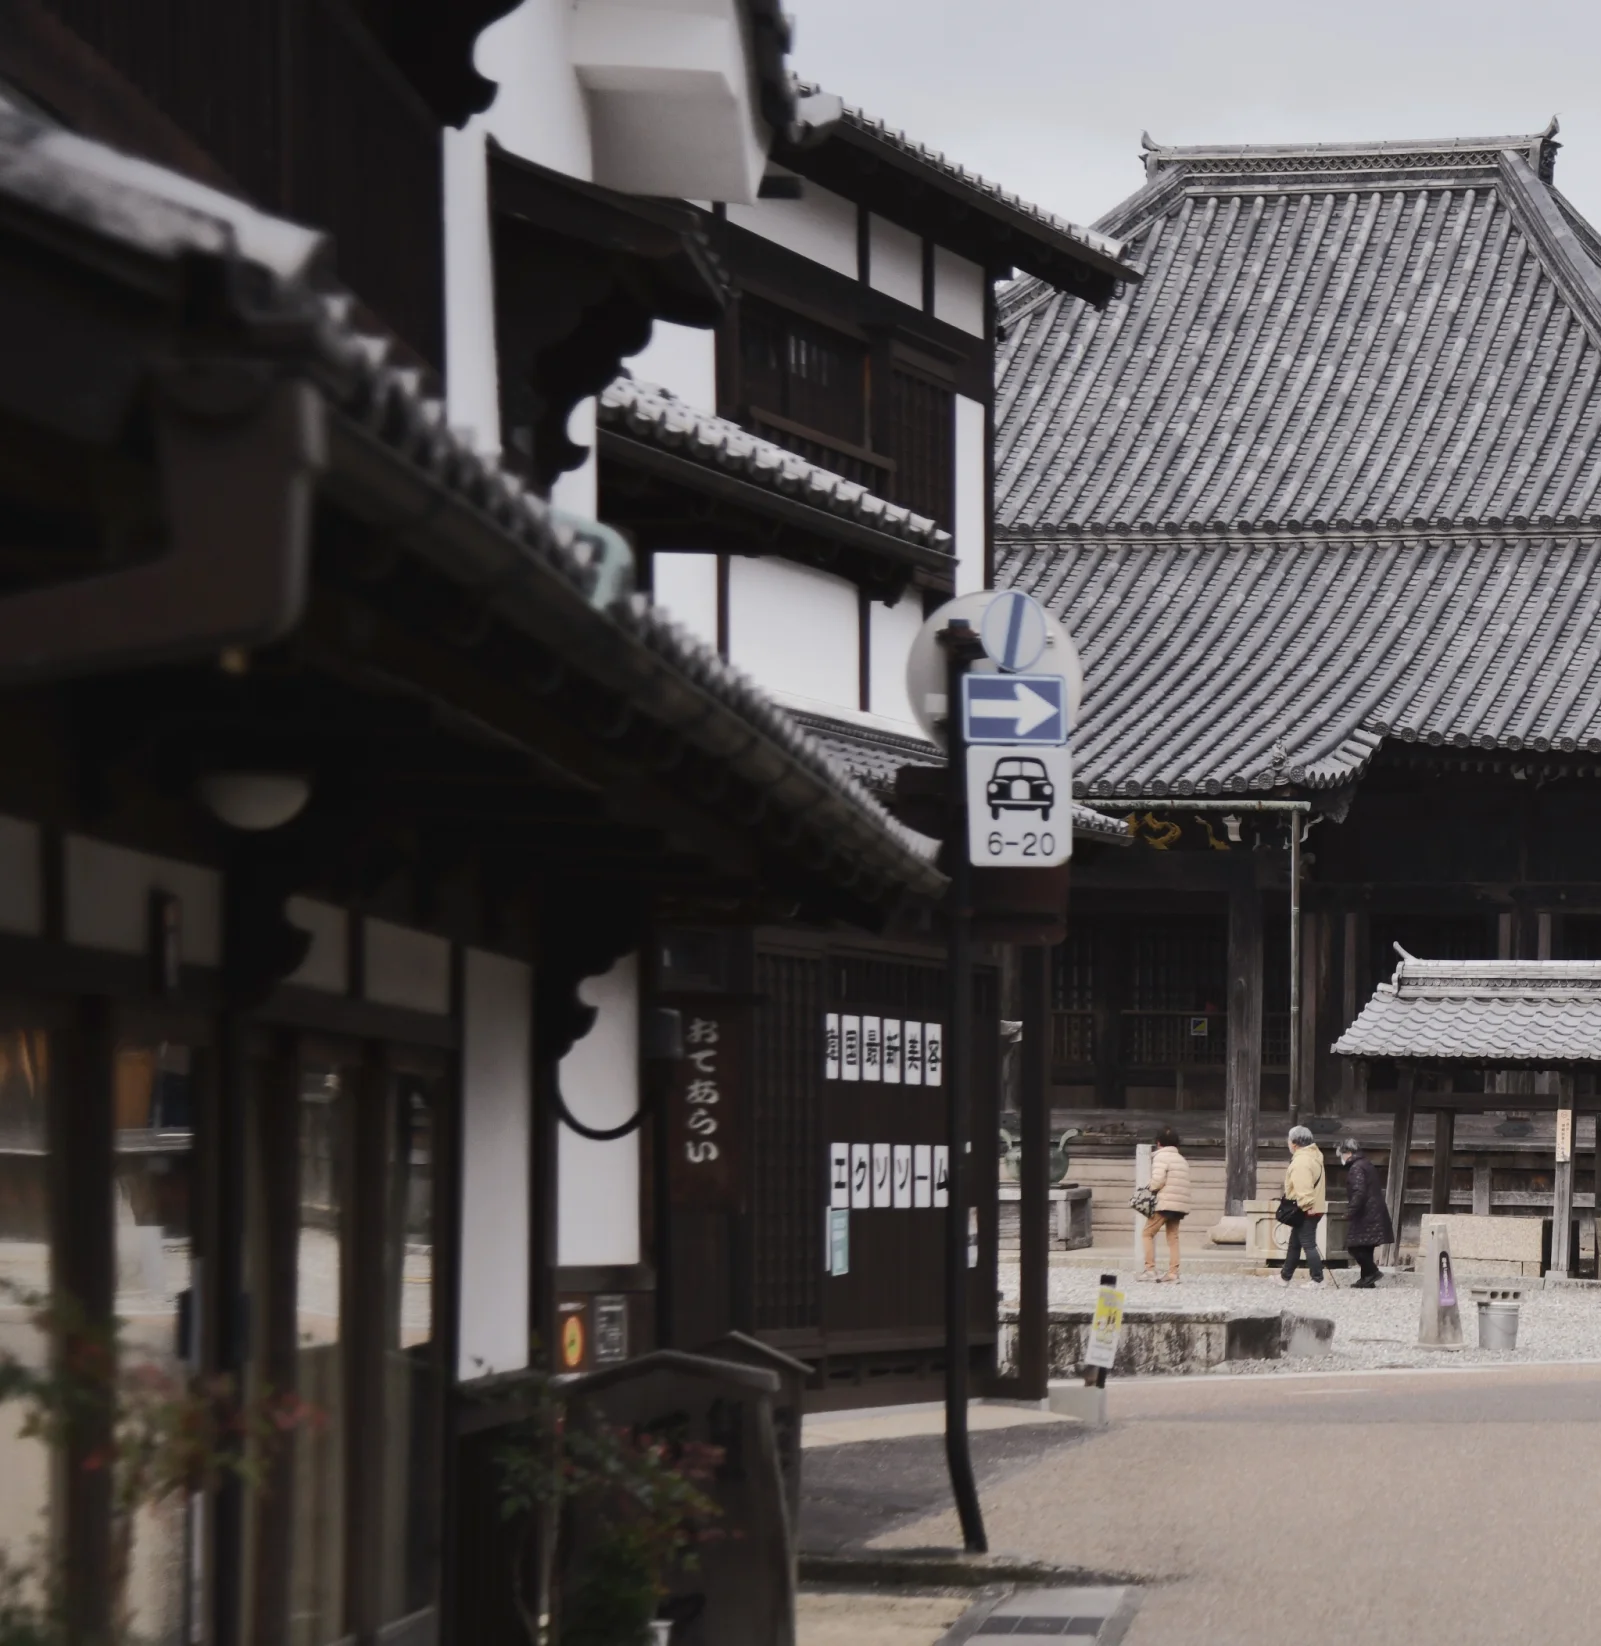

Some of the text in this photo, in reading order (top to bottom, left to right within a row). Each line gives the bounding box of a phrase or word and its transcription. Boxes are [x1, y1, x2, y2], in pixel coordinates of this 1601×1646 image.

[988, 831, 1055, 856] 6-20
[685, 1017, 721, 1164] おてあらい
[834, 1157, 949, 1192] エクソソーム
